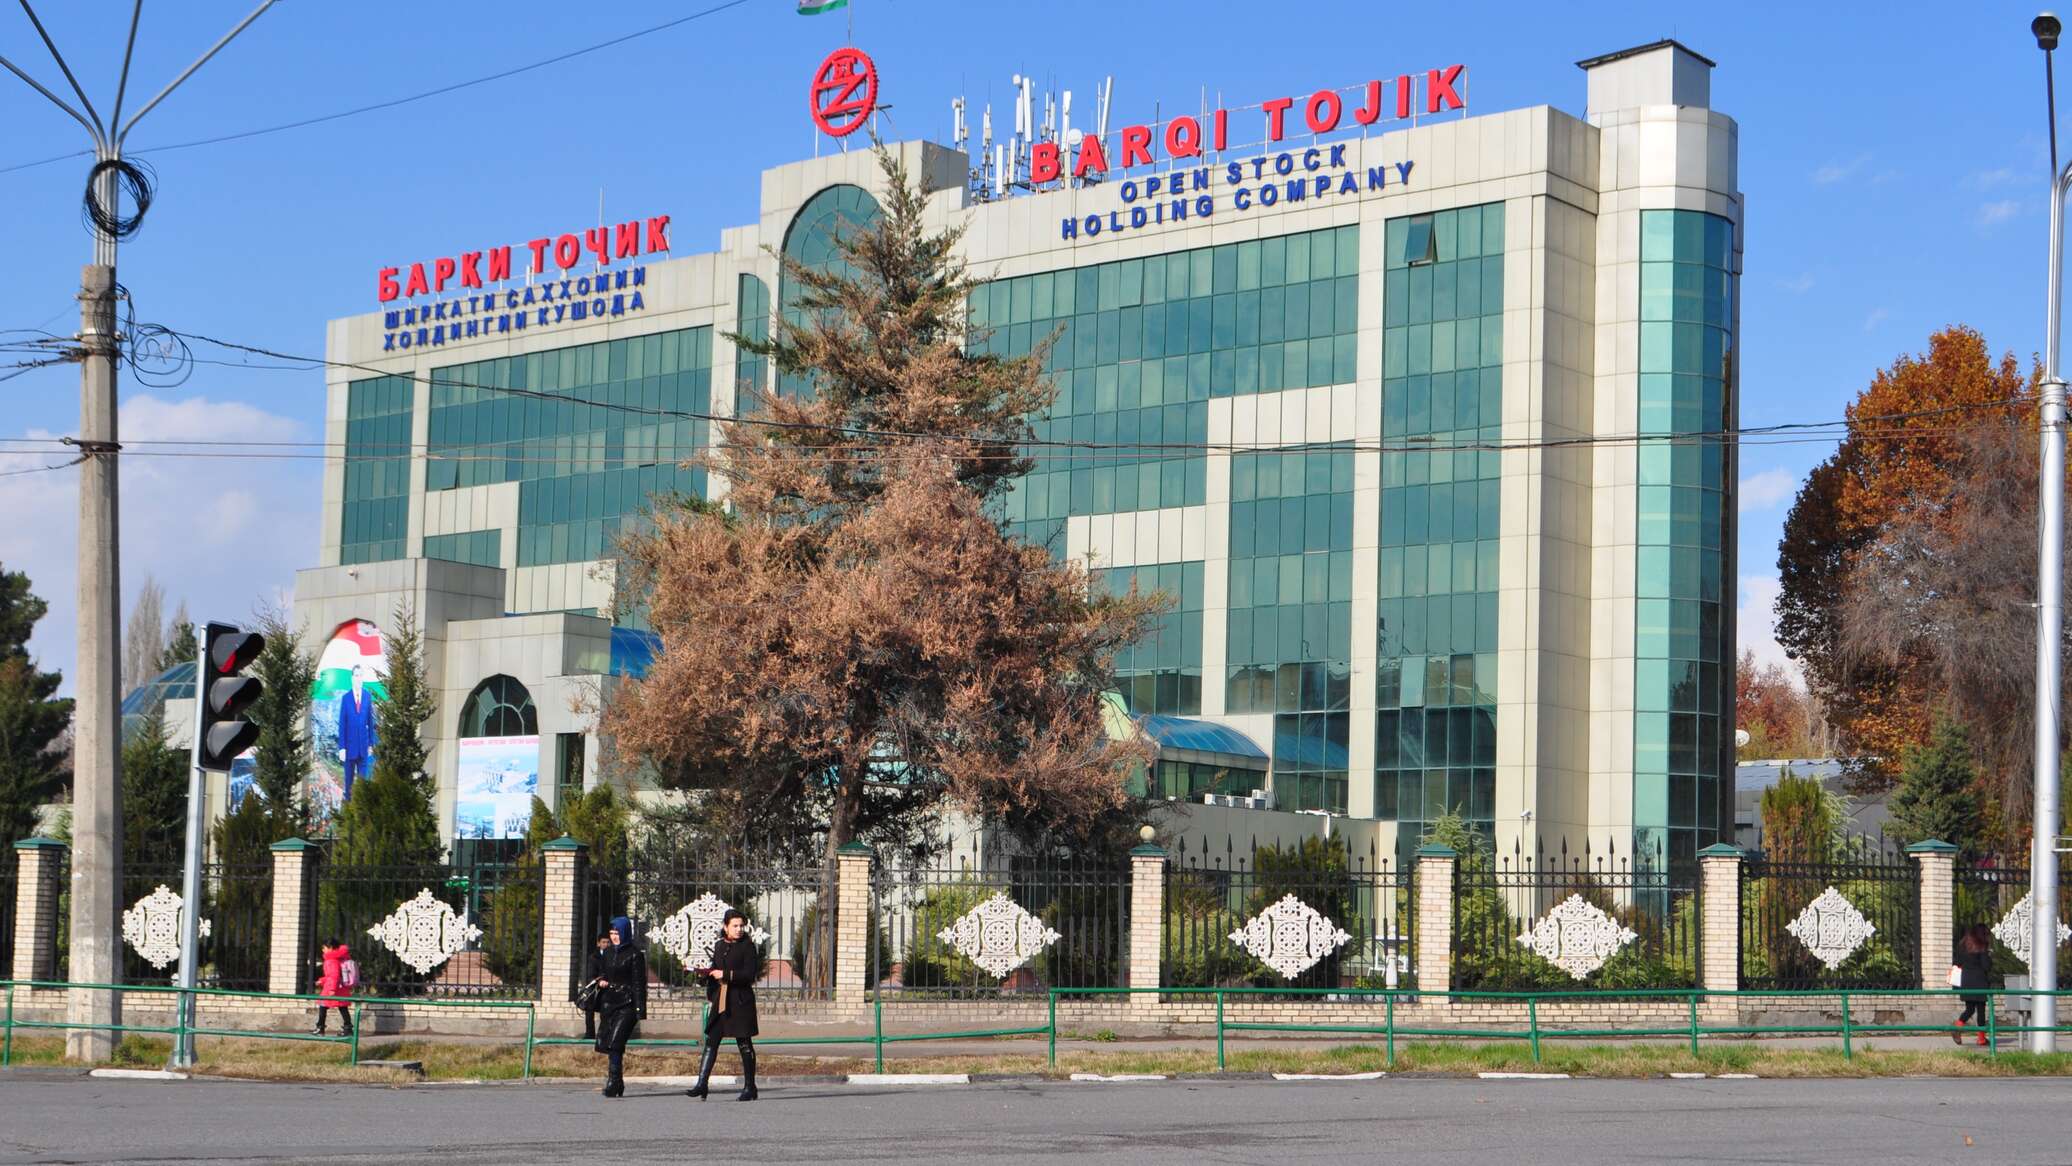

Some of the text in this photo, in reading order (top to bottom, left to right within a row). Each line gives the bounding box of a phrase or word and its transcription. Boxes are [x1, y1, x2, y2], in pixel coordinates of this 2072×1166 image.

[1031, 65, 1464, 183] BARQI TOJIK
[1062, 160, 1413, 240] HOLDING COMPANY
[1120, 143, 1346, 203] OPEN STOCK
[384, 293, 495, 329] ШИРКАТИ
[538, 291, 645, 327] КУШОДА
